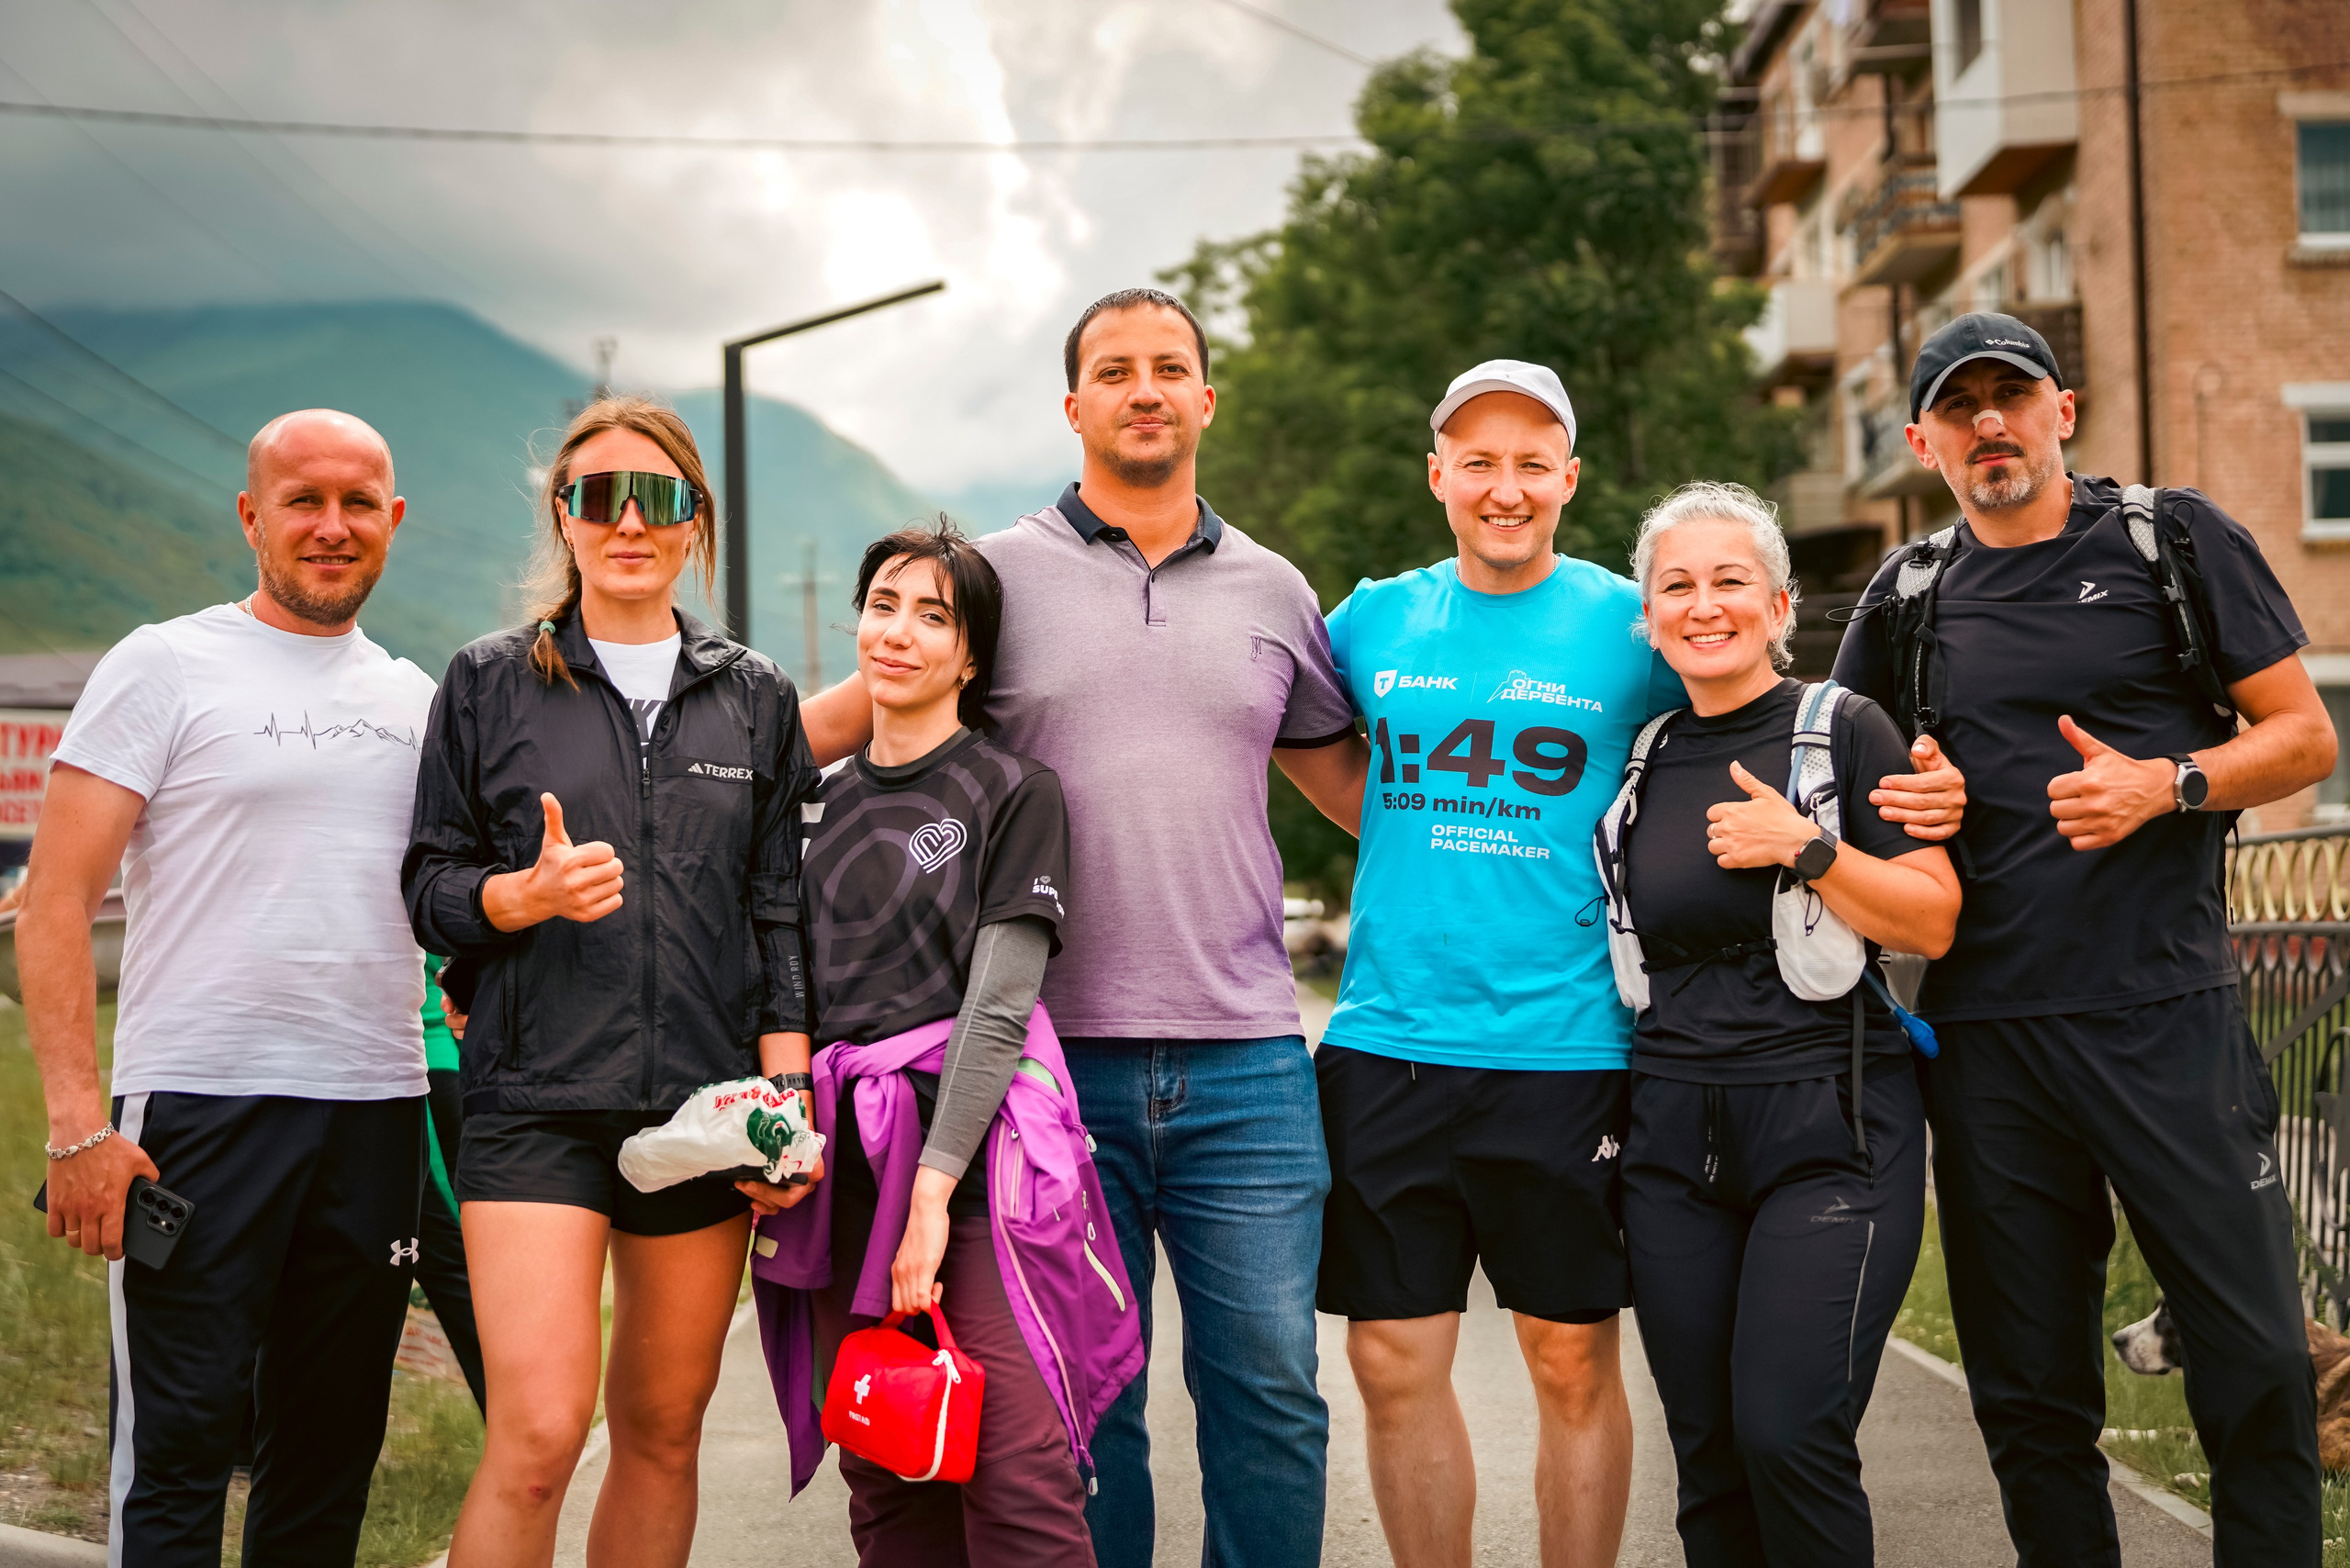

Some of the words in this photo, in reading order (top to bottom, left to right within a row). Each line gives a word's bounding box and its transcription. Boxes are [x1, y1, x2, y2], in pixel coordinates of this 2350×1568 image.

[1994, 339, 2031, 349] Columbia
[2076, 589, 2109, 603] EMIX
[1397, 675, 1460, 690] БАНК
[1512, 678, 1566, 695] ОГНИ
[1500, 688, 1603, 713] ДЕРБЕНТА
[1375, 716, 1588, 797] 1:49
[704, 763, 754, 781] TERREX
[1382, 792, 1426, 811] 5:09
[1433, 795, 1541, 821] min/km
[1431, 823, 1519, 843] OFFICIAL
[1430, 837, 1550, 860] PACEMAKER
